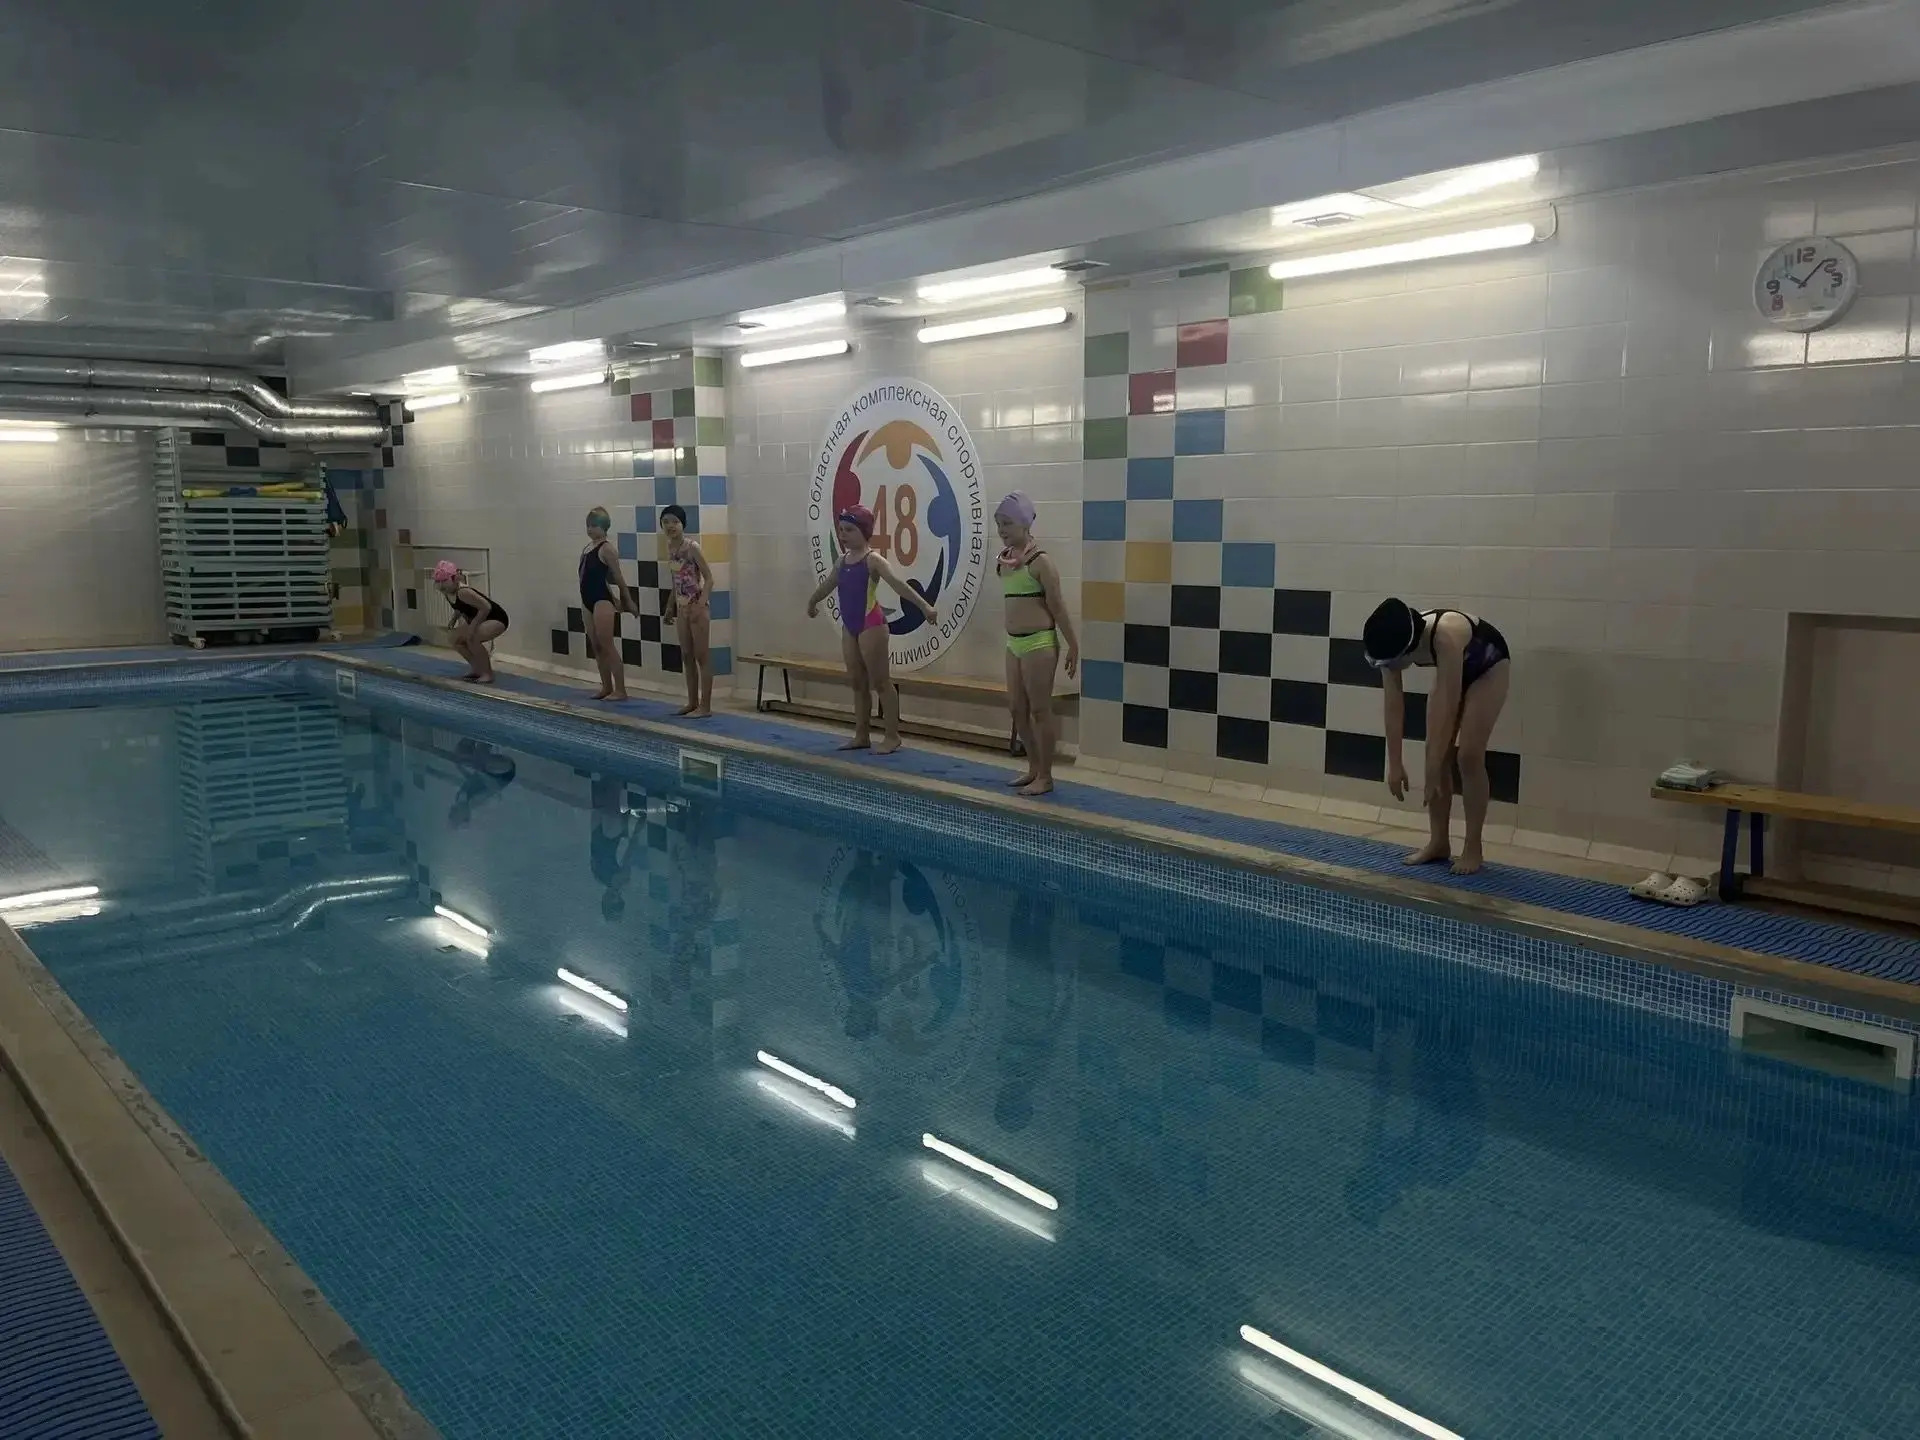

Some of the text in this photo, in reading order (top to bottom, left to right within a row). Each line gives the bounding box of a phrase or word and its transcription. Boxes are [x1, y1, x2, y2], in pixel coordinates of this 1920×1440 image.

[1797, 247, 1816, 264] 12
[1824, 258, 1837, 274] 2
[1831, 272, 1843, 287] 3
[1766, 280, 1780, 296] 9
[809, 385, 982, 664] Областная комплексная спортивная школа олимпи реерва
[869, 484, 918, 567] 48
